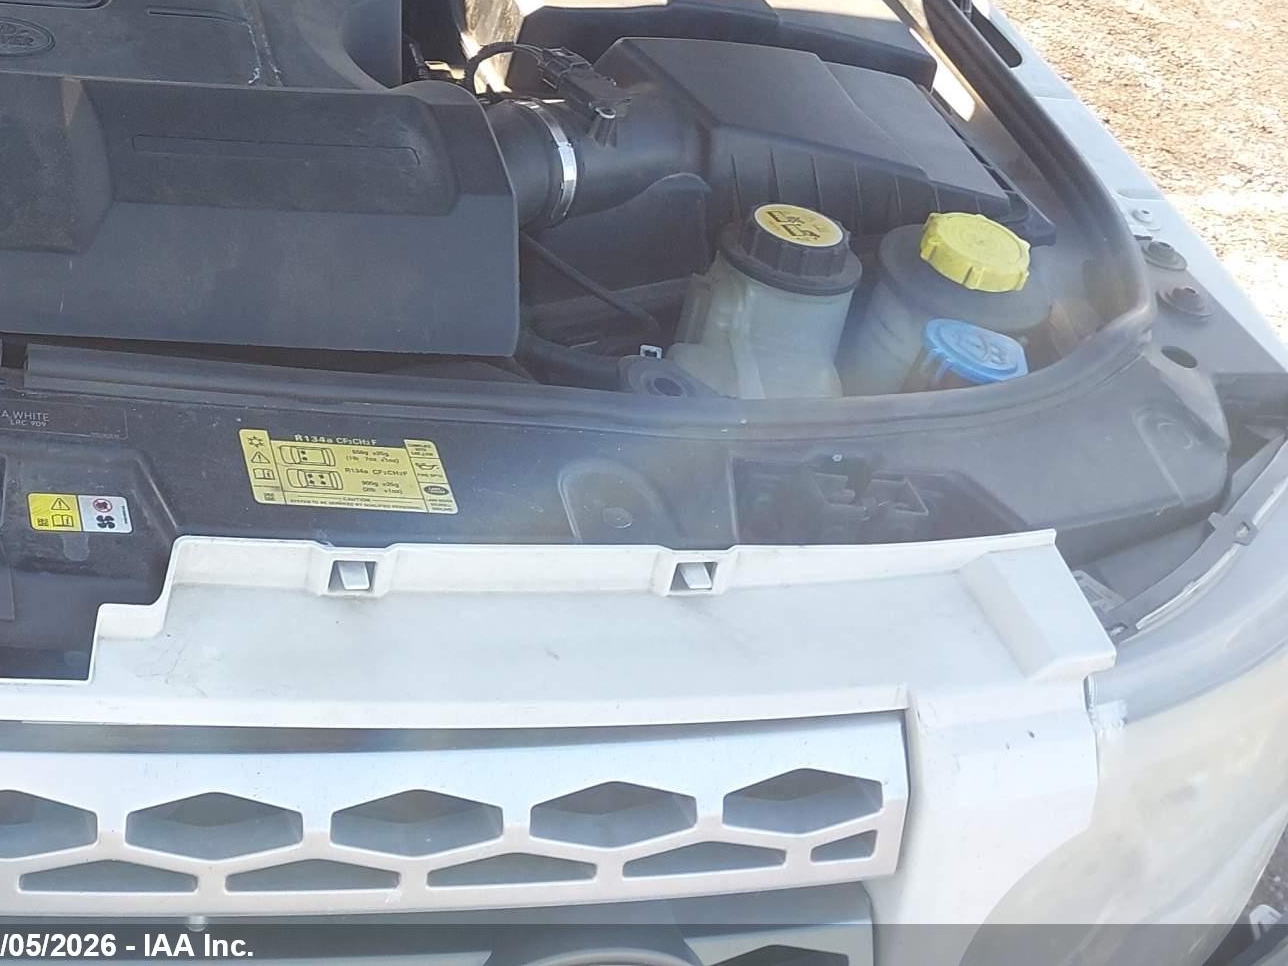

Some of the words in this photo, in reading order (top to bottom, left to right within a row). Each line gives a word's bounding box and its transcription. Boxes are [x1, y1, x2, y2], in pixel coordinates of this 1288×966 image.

[12, 411, 50, 422] WHITE
[10, 418, 28, 426] LRC
[294, 434, 334, 444] R134a
